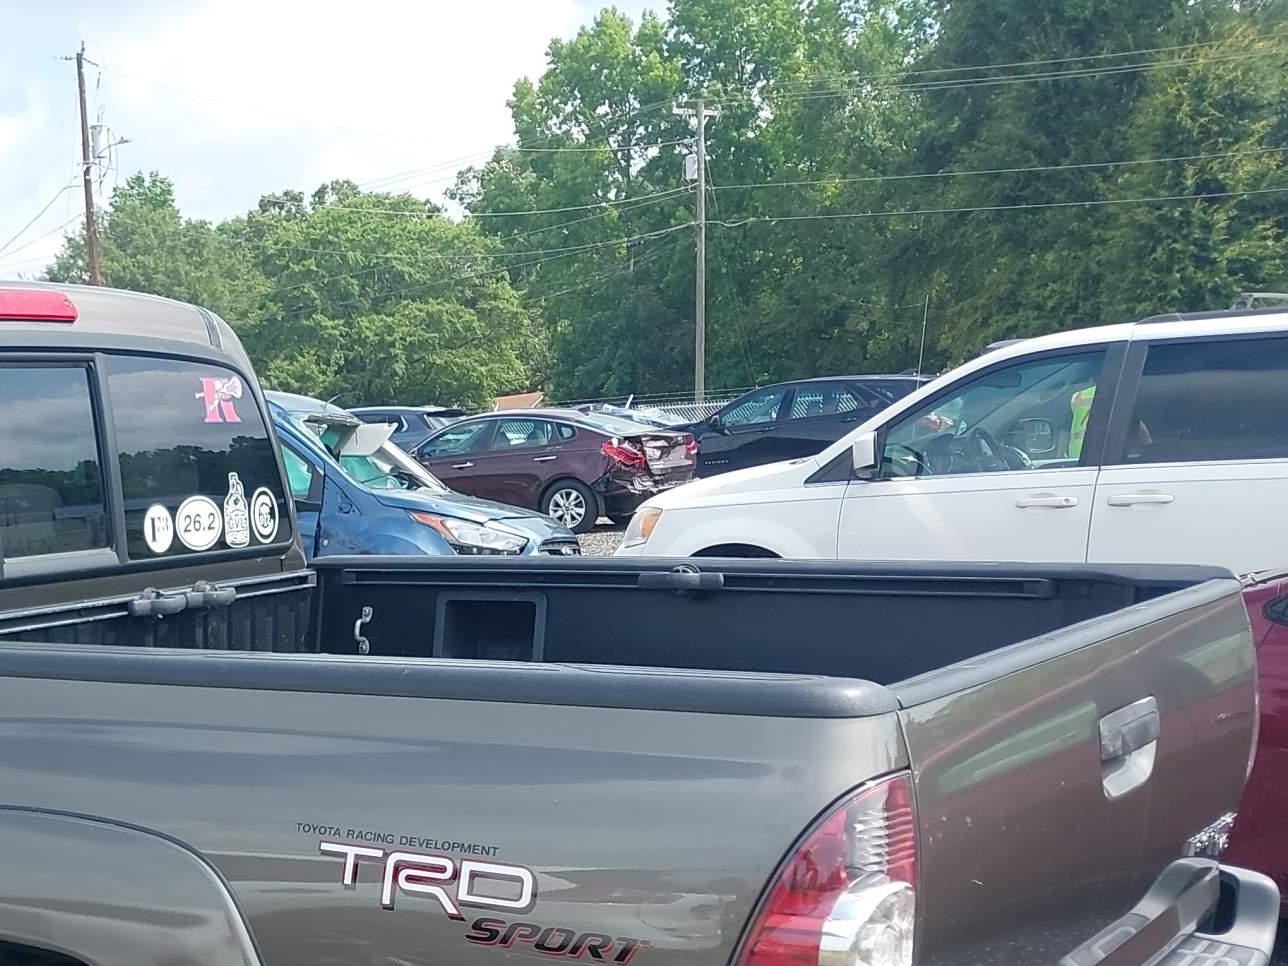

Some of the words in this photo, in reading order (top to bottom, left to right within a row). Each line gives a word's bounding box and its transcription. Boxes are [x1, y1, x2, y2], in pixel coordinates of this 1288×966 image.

[183, 512, 216, 533] 26.2
[296, 822, 342, 838] TOYOTA
[346, 829, 395, 844] RACING
[399, 836, 499, 857] DEVELOPMENT
[319, 841, 538, 921] TRD
[465, 917, 654, 966] SPORT
